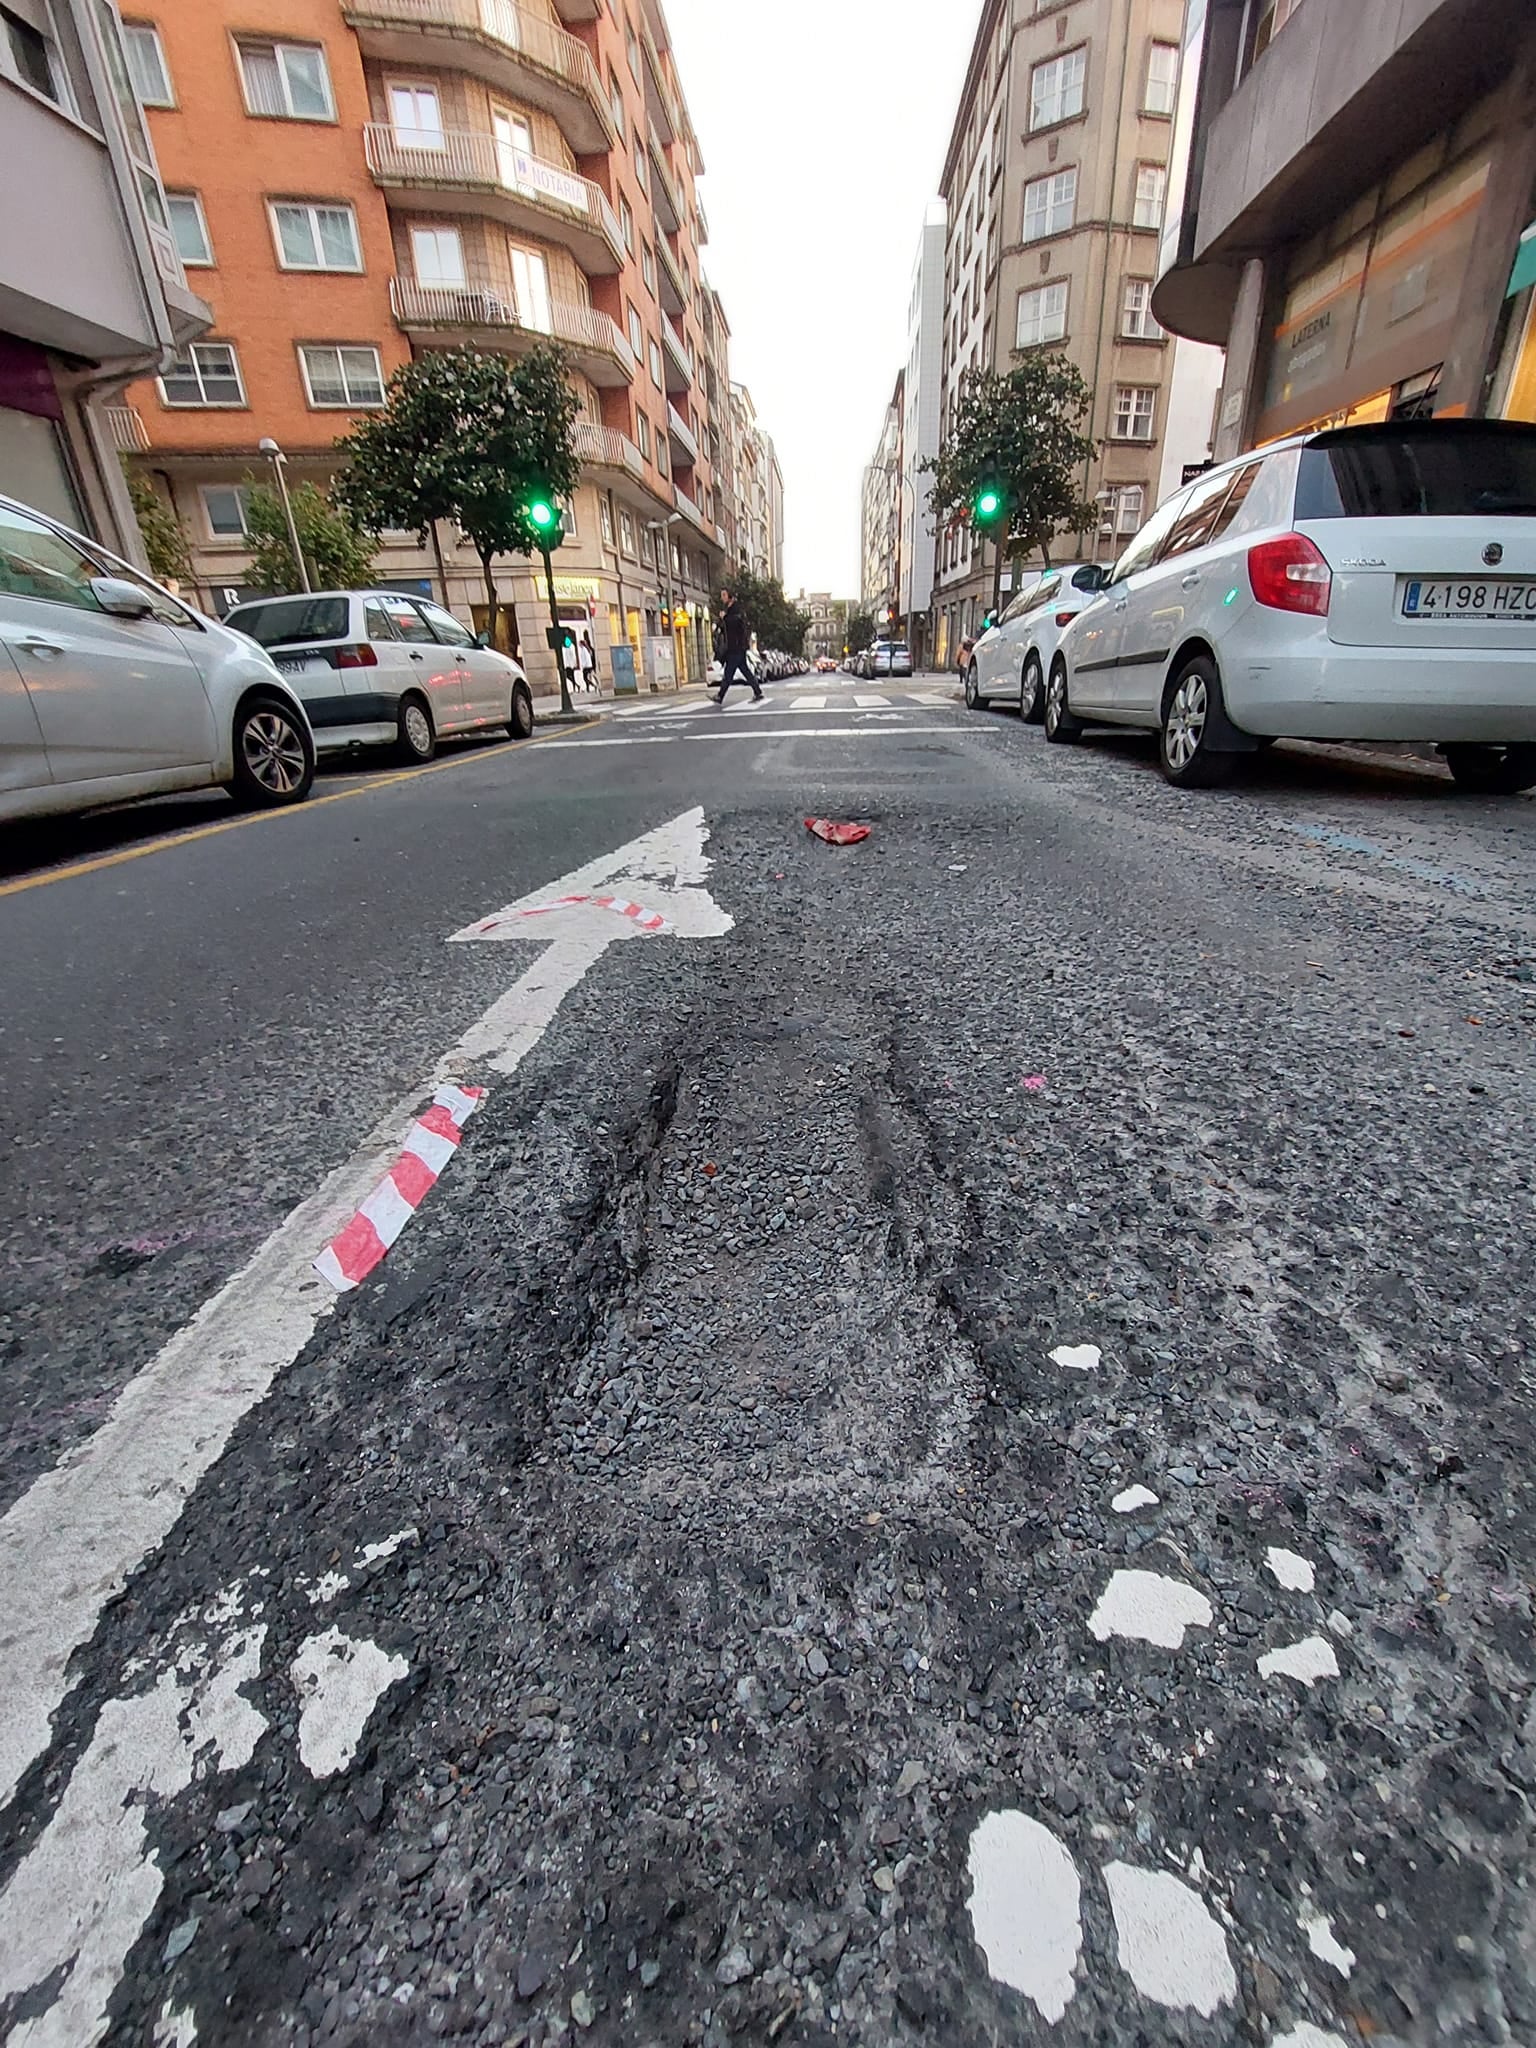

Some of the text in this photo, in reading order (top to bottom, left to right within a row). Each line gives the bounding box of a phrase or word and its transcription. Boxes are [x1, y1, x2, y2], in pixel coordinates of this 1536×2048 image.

[532, 167, 583, 202] NOTARIA
[1291, 311, 1331, 348] LATERNA
[223, 588, 240, 604] R
[1423, 586, 1487, 608] 4198
